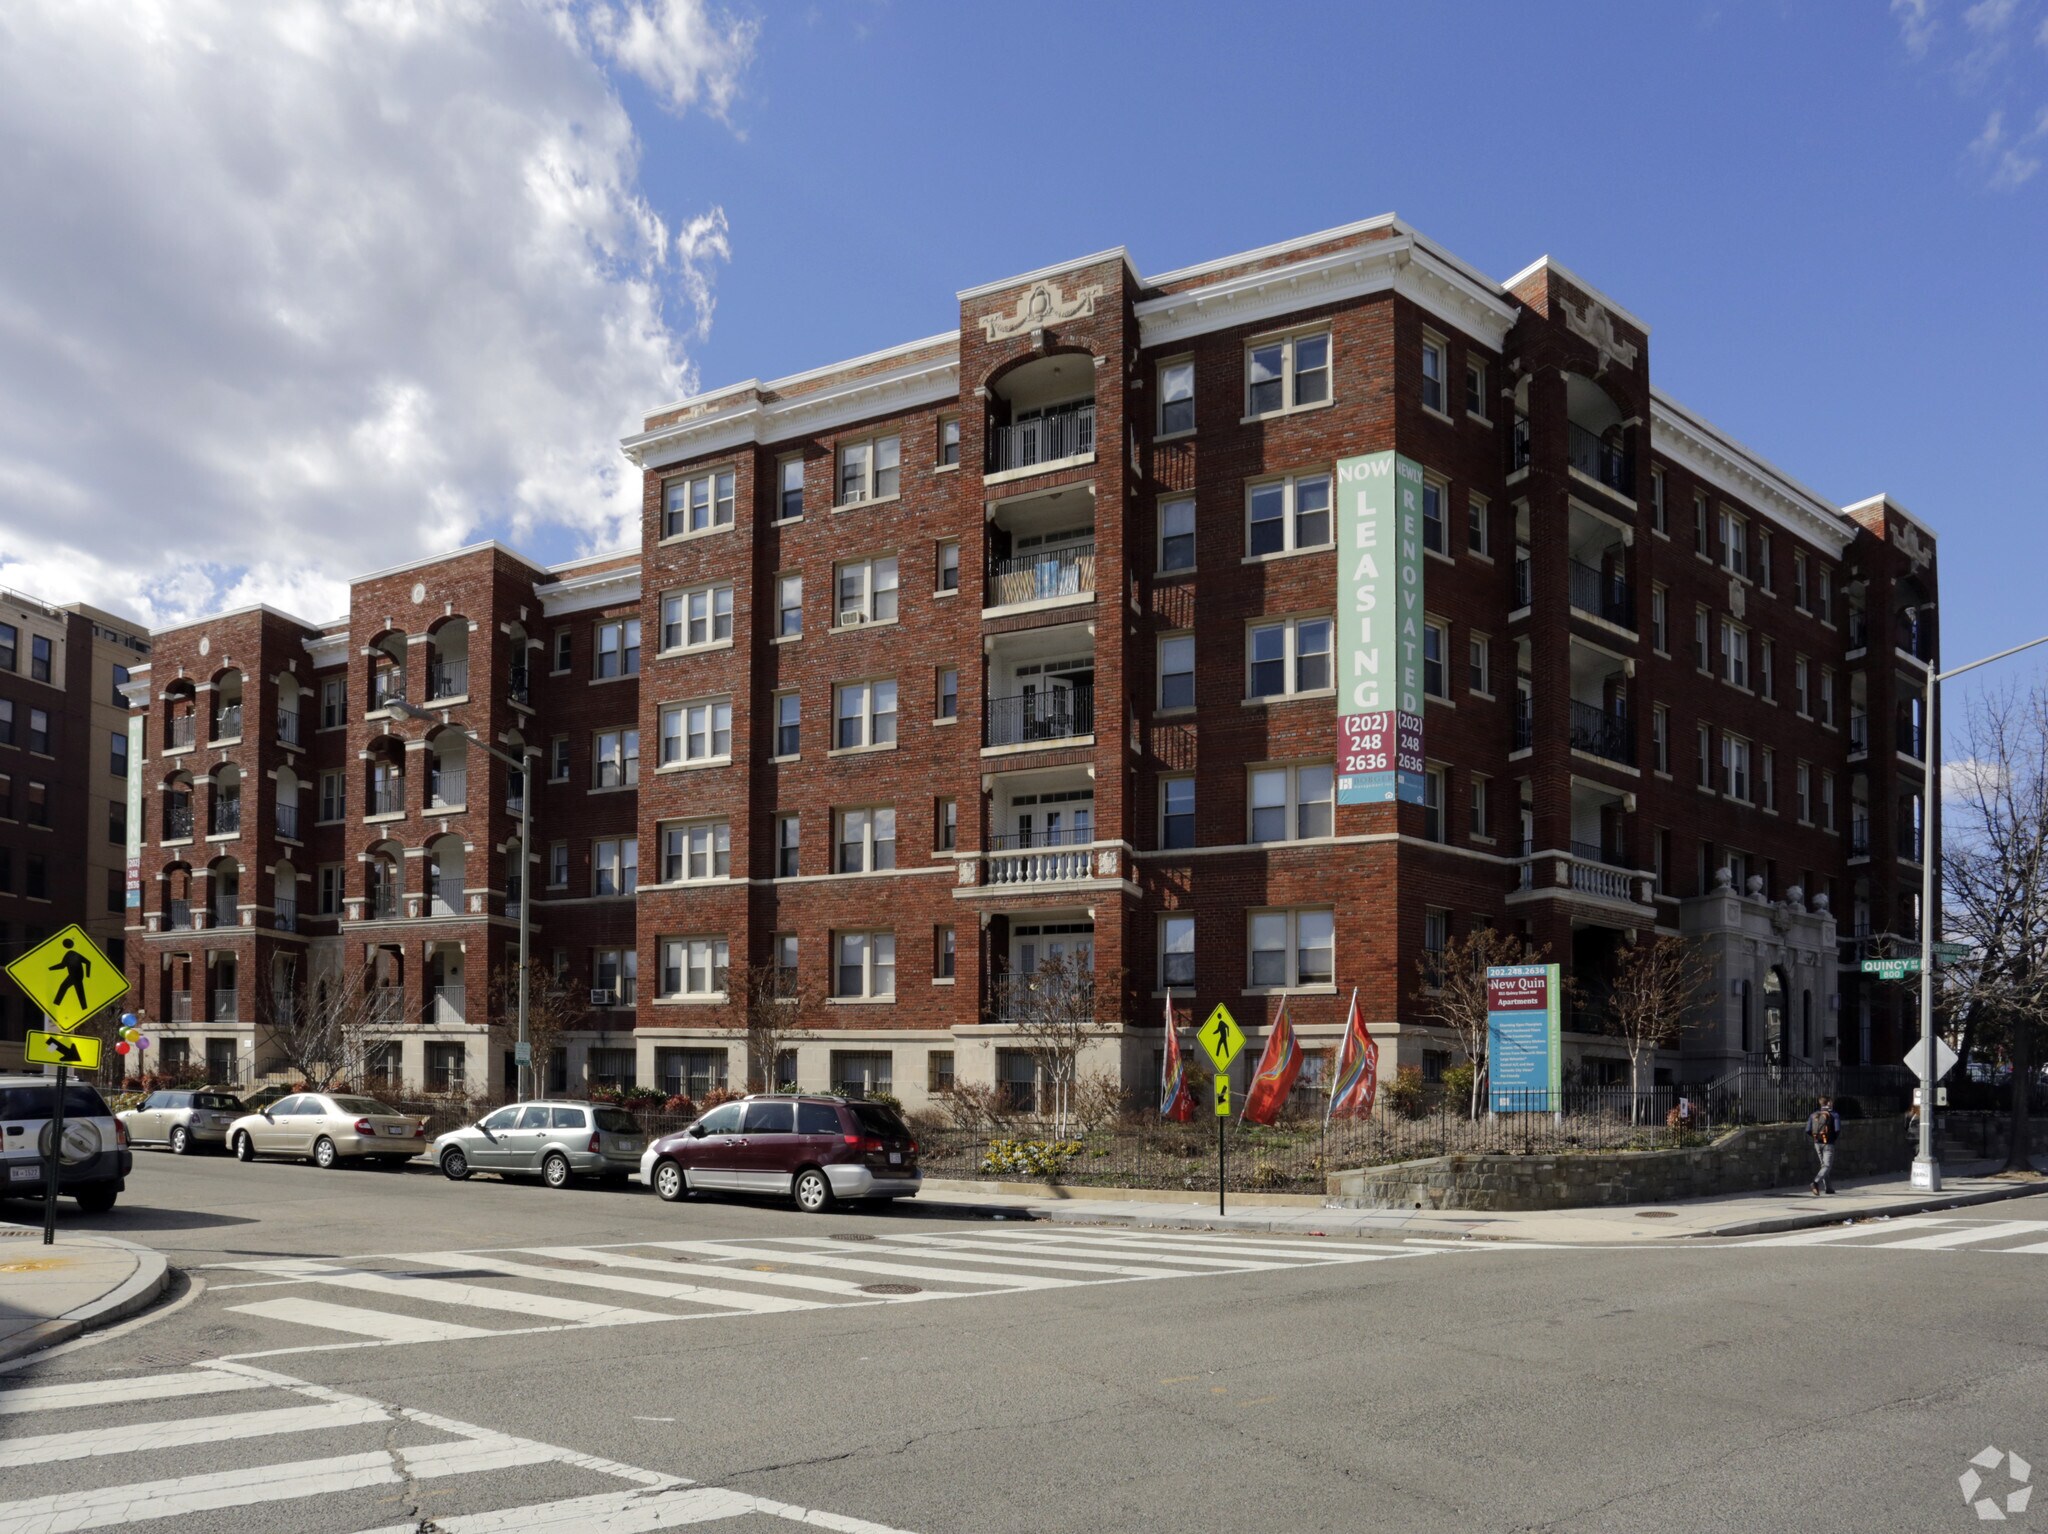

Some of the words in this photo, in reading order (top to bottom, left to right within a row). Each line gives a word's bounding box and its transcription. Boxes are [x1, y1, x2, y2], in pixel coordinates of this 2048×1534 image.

[1338, 458, 1391, 484] NOW
[1397, 460, 1423, 485] NEWLY
[1353, 490, 1380, 708] LEASING
[1403, 488, 1417, 712] RENOVATED
[1344, 712, 1388, 736] (202)
[1397, 711, 1423, 735] (202)
[1351, 735, 1382, 751] 248
[1401, 734, 1420, 752] 248
[1346, 753, 1387, 772] 2636
[1398, 753, 1423, 772] 2636
[130, 735, 138, 855] LEASING
[1490, 967, 1545, 976] 202.248.2636
[1864, 961, 1909, 971] QUINCY
[1491, 979, 1516, 990] New
[1518, 978, 1545, 990] Quin
[1498, 998, 1538, 1007] Apartments
